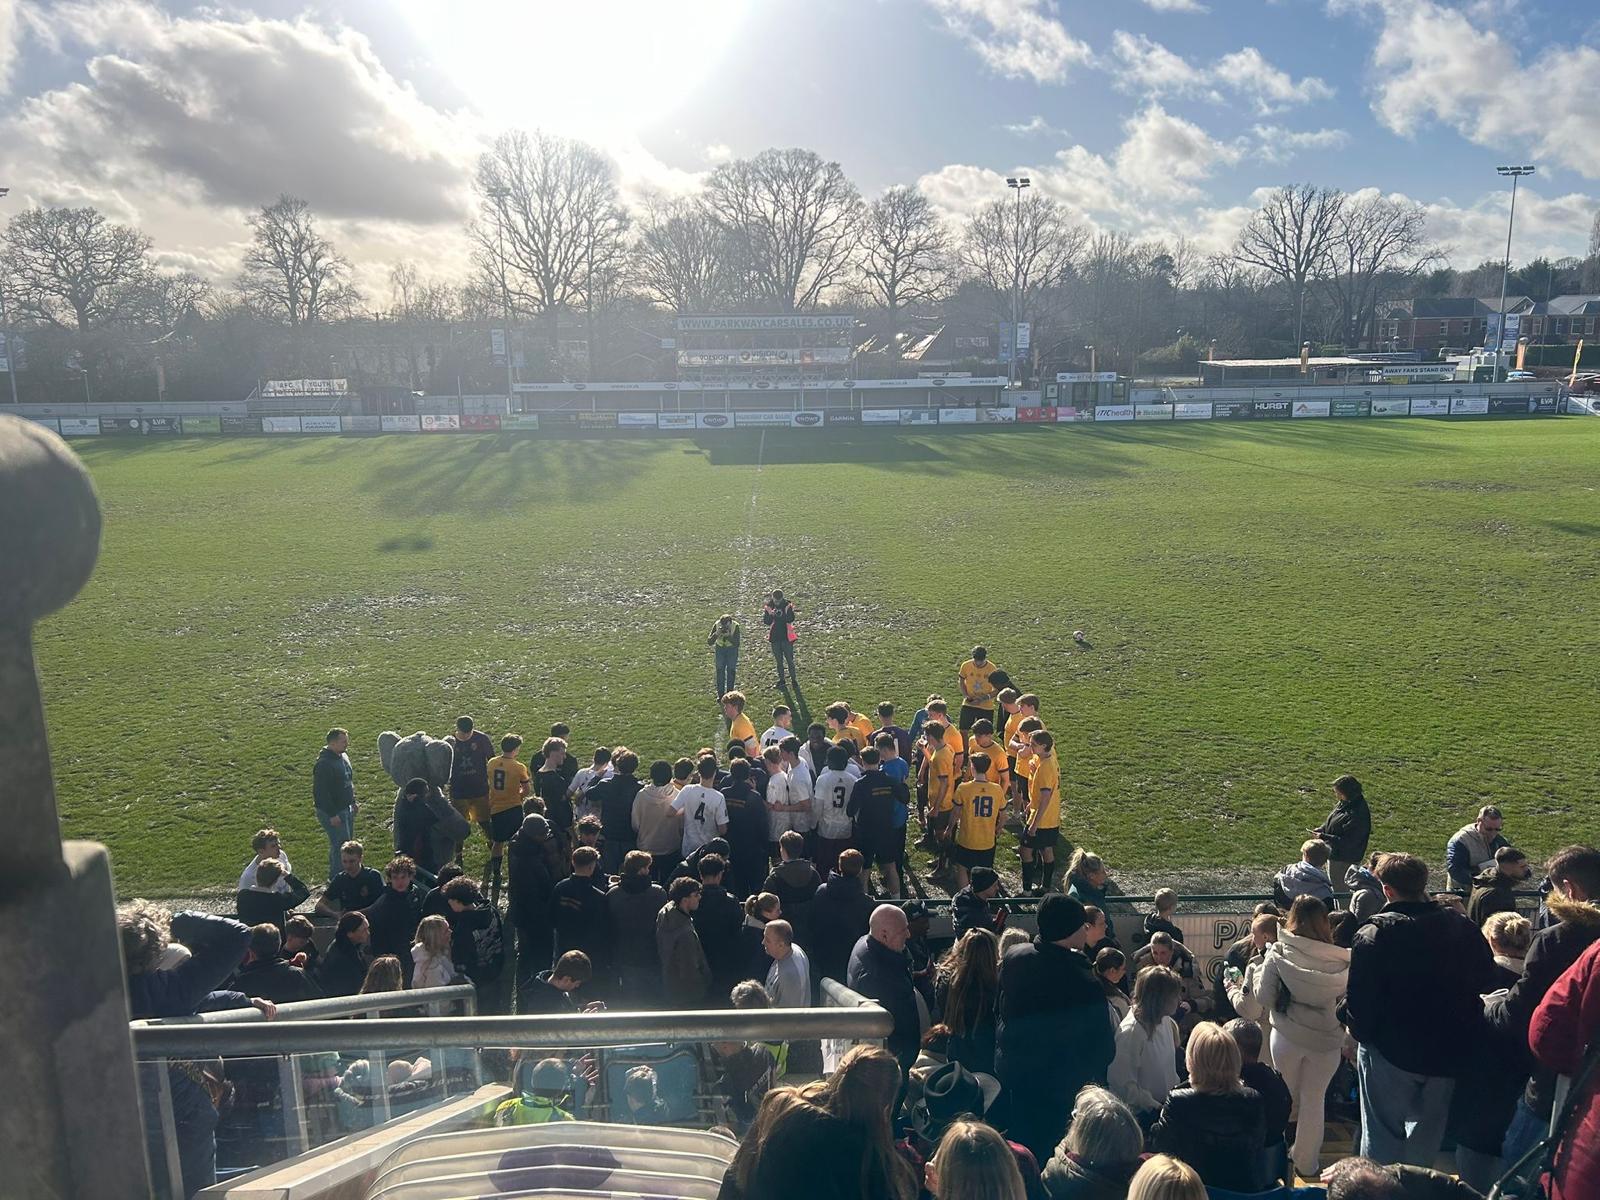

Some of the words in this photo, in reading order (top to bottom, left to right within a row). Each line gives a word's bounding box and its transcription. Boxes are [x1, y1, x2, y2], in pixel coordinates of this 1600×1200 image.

[681, 317, 851, 329] WWW.PARKWAYCARSALES.CO.UK
[1255, 402, 1289, 410] HURST
[494, 769, 505, 790] 8
[832, 786, 846, 808] 3
[973, 796, 993, 817] 18
[694, 801, 706, 825] 4
